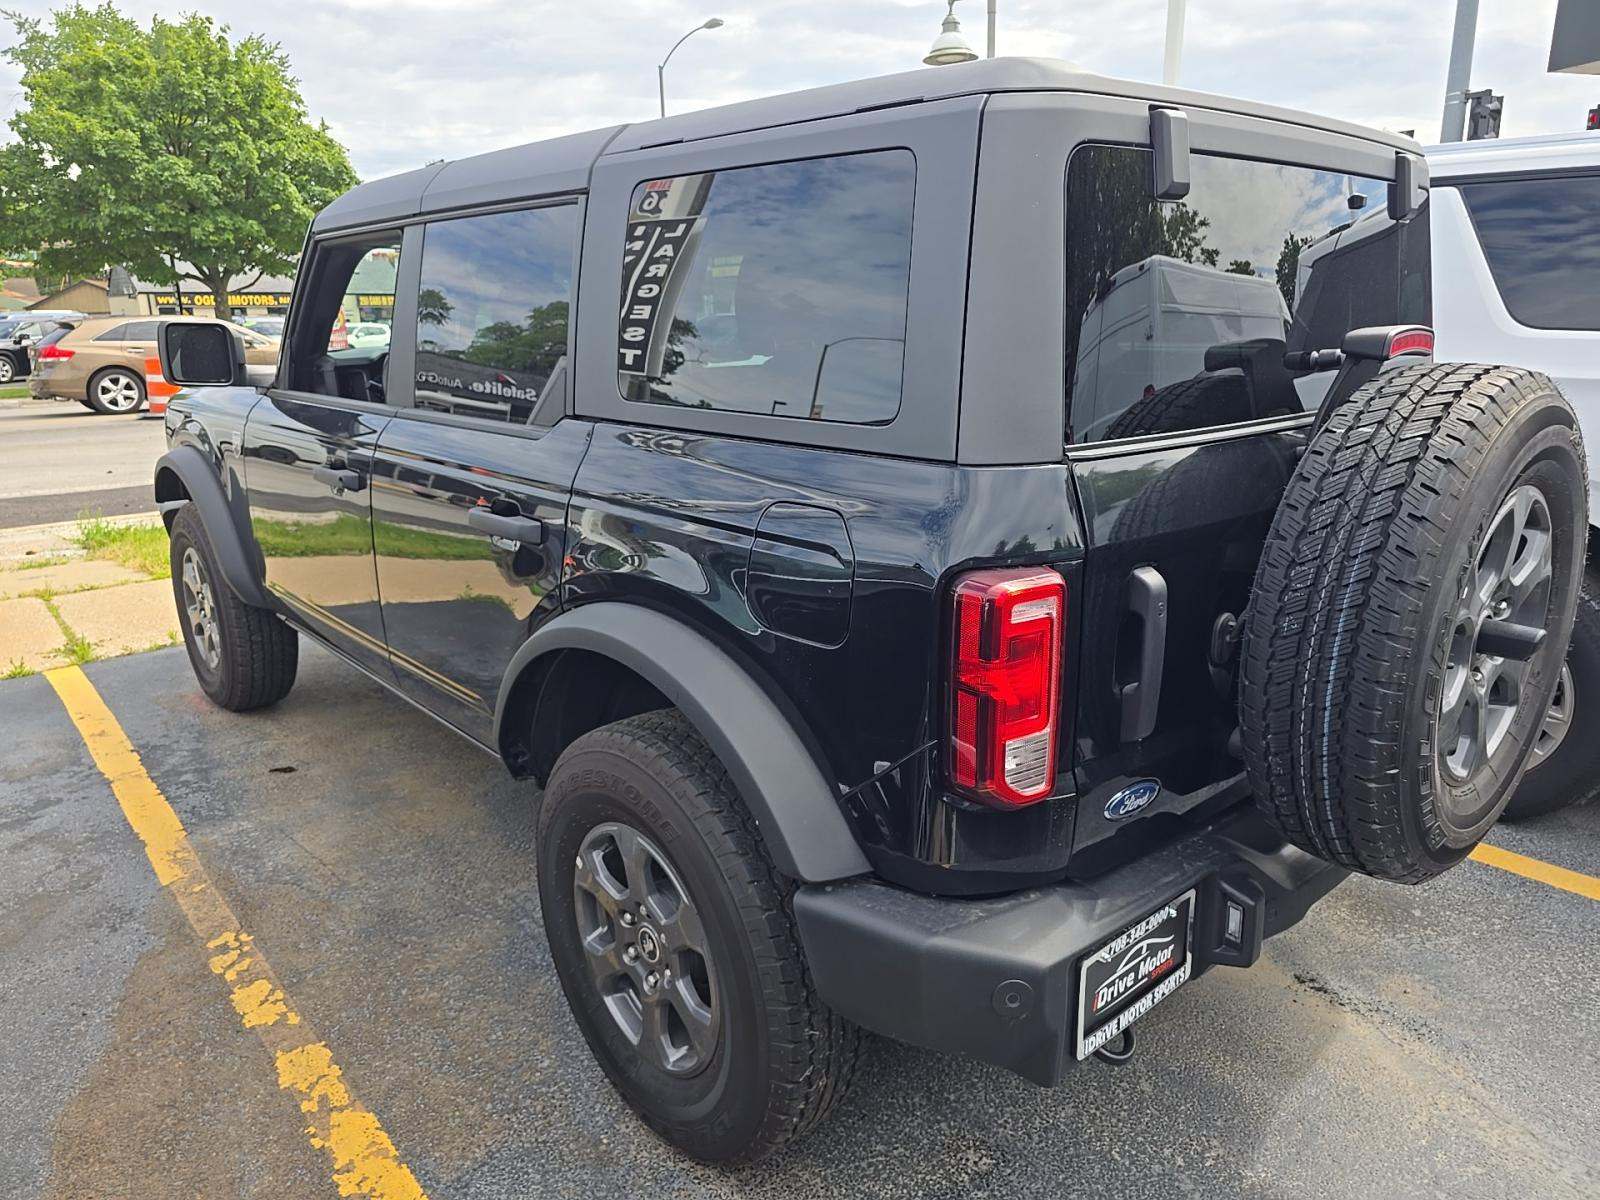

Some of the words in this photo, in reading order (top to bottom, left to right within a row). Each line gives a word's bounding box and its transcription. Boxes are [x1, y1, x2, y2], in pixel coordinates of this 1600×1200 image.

[1119, 789, 1150, 815] Ford
[1138, 944, 1175, 979] Motor
[1119, 994, 1153, 1030] MOTOR
[1153, 968, 1186, 1003] SPORTS
